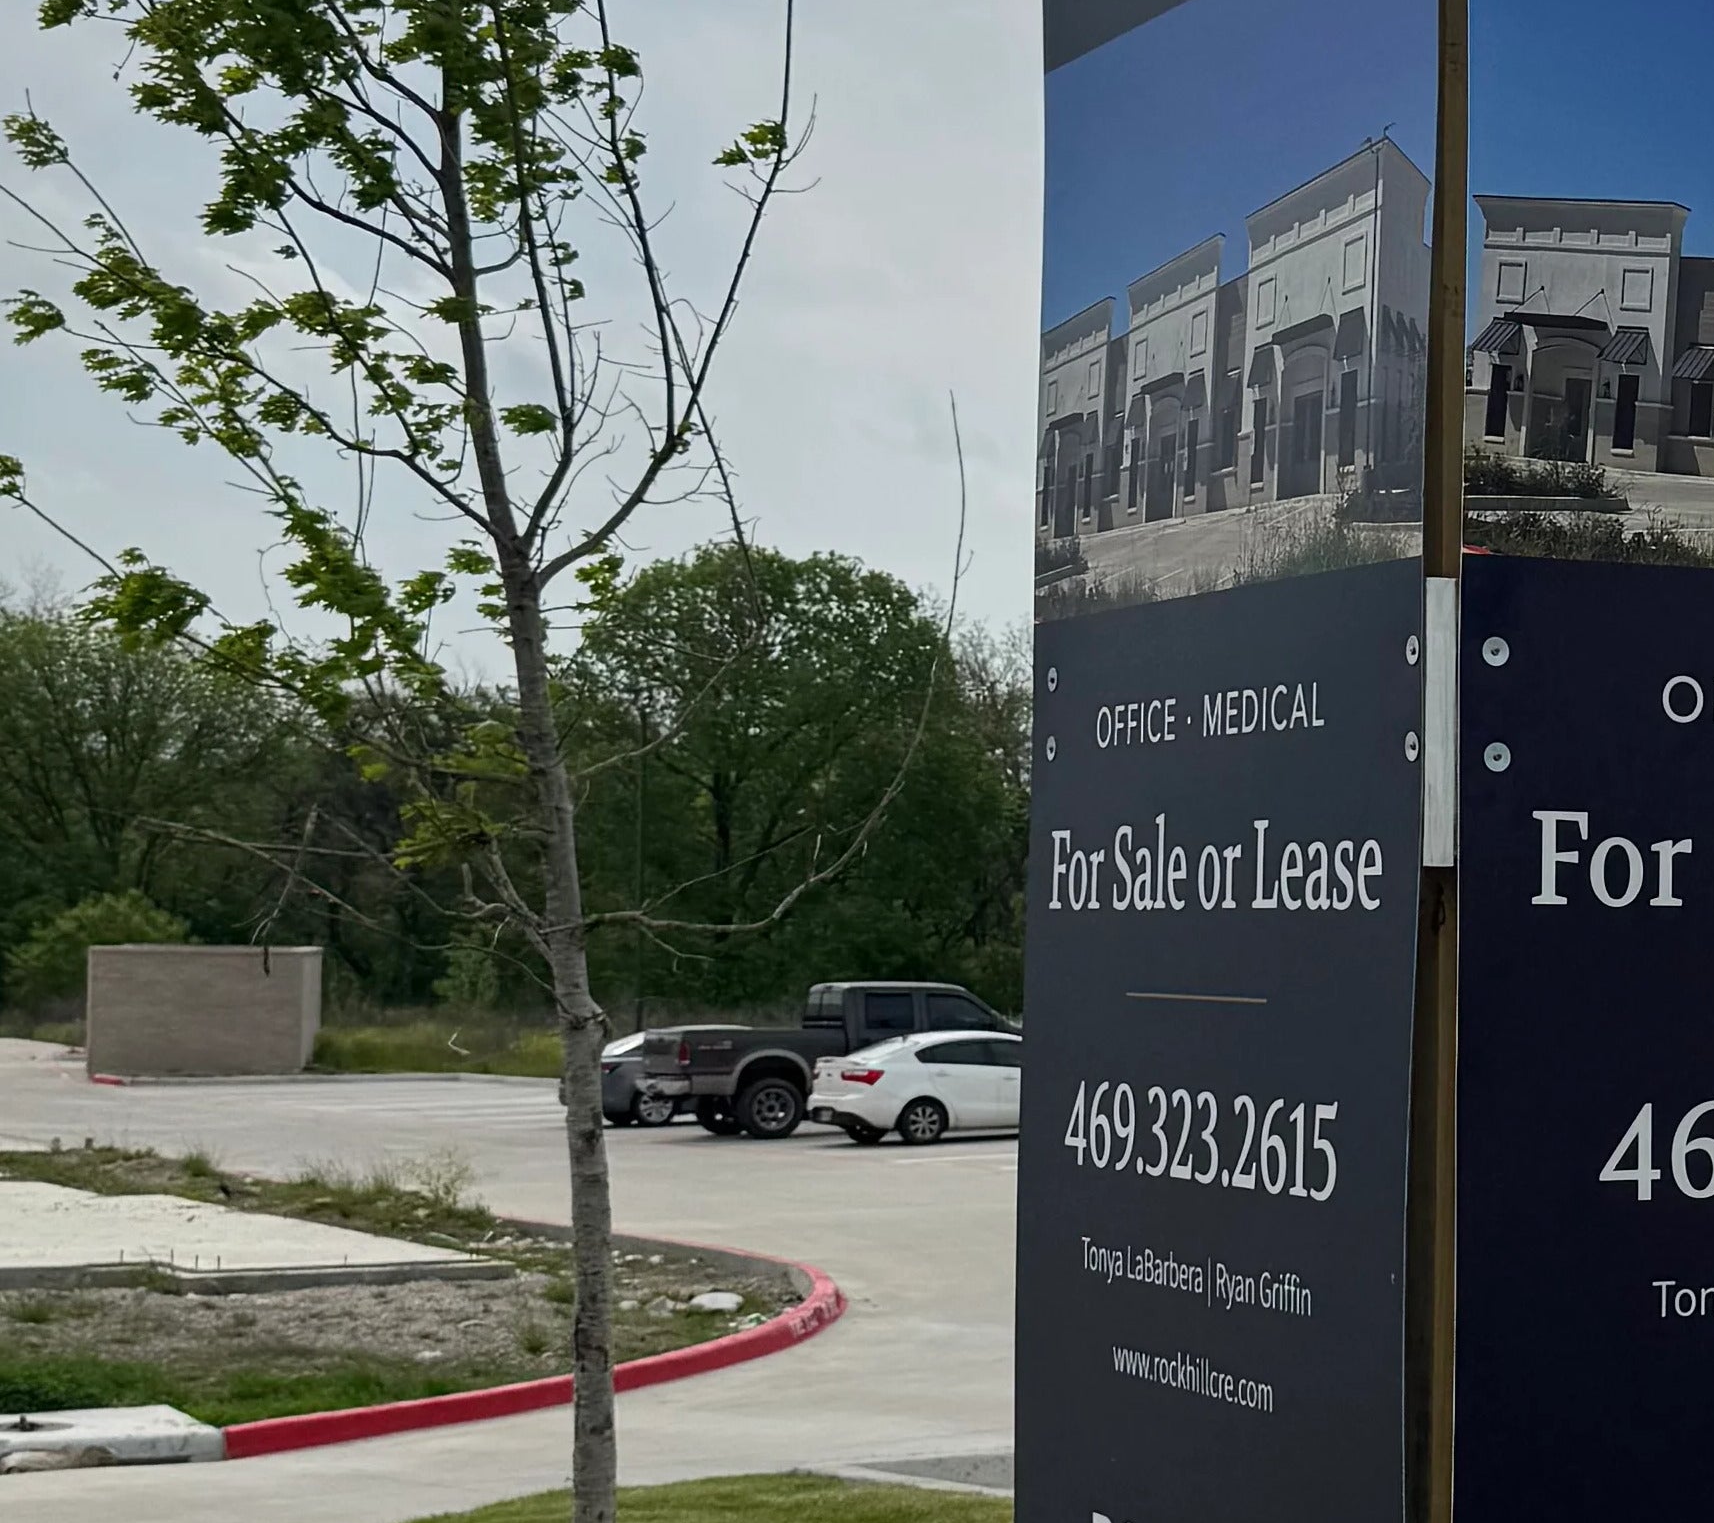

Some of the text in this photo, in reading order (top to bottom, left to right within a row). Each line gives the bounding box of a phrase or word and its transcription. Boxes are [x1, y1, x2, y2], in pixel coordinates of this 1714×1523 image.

[1096, 681, 1325, 749] OFFICE MEDICAL
[1048, 812, 1383, 911] For Sale or Lease
[1531, 810, 1693, 908] For
[1064, 1080, 1338, 1202] 469.323.2615
[1081, 1236, 1123, 1284] Tonya
[1127, 1245, 1203, 1294] LaBarbera
[1216, 1262, 1255, 1310] Ryan
[1259, 1271, 1312, 1317] Griffin
[1112, 1346, 1273, 1413] www.rockhillcre.com
